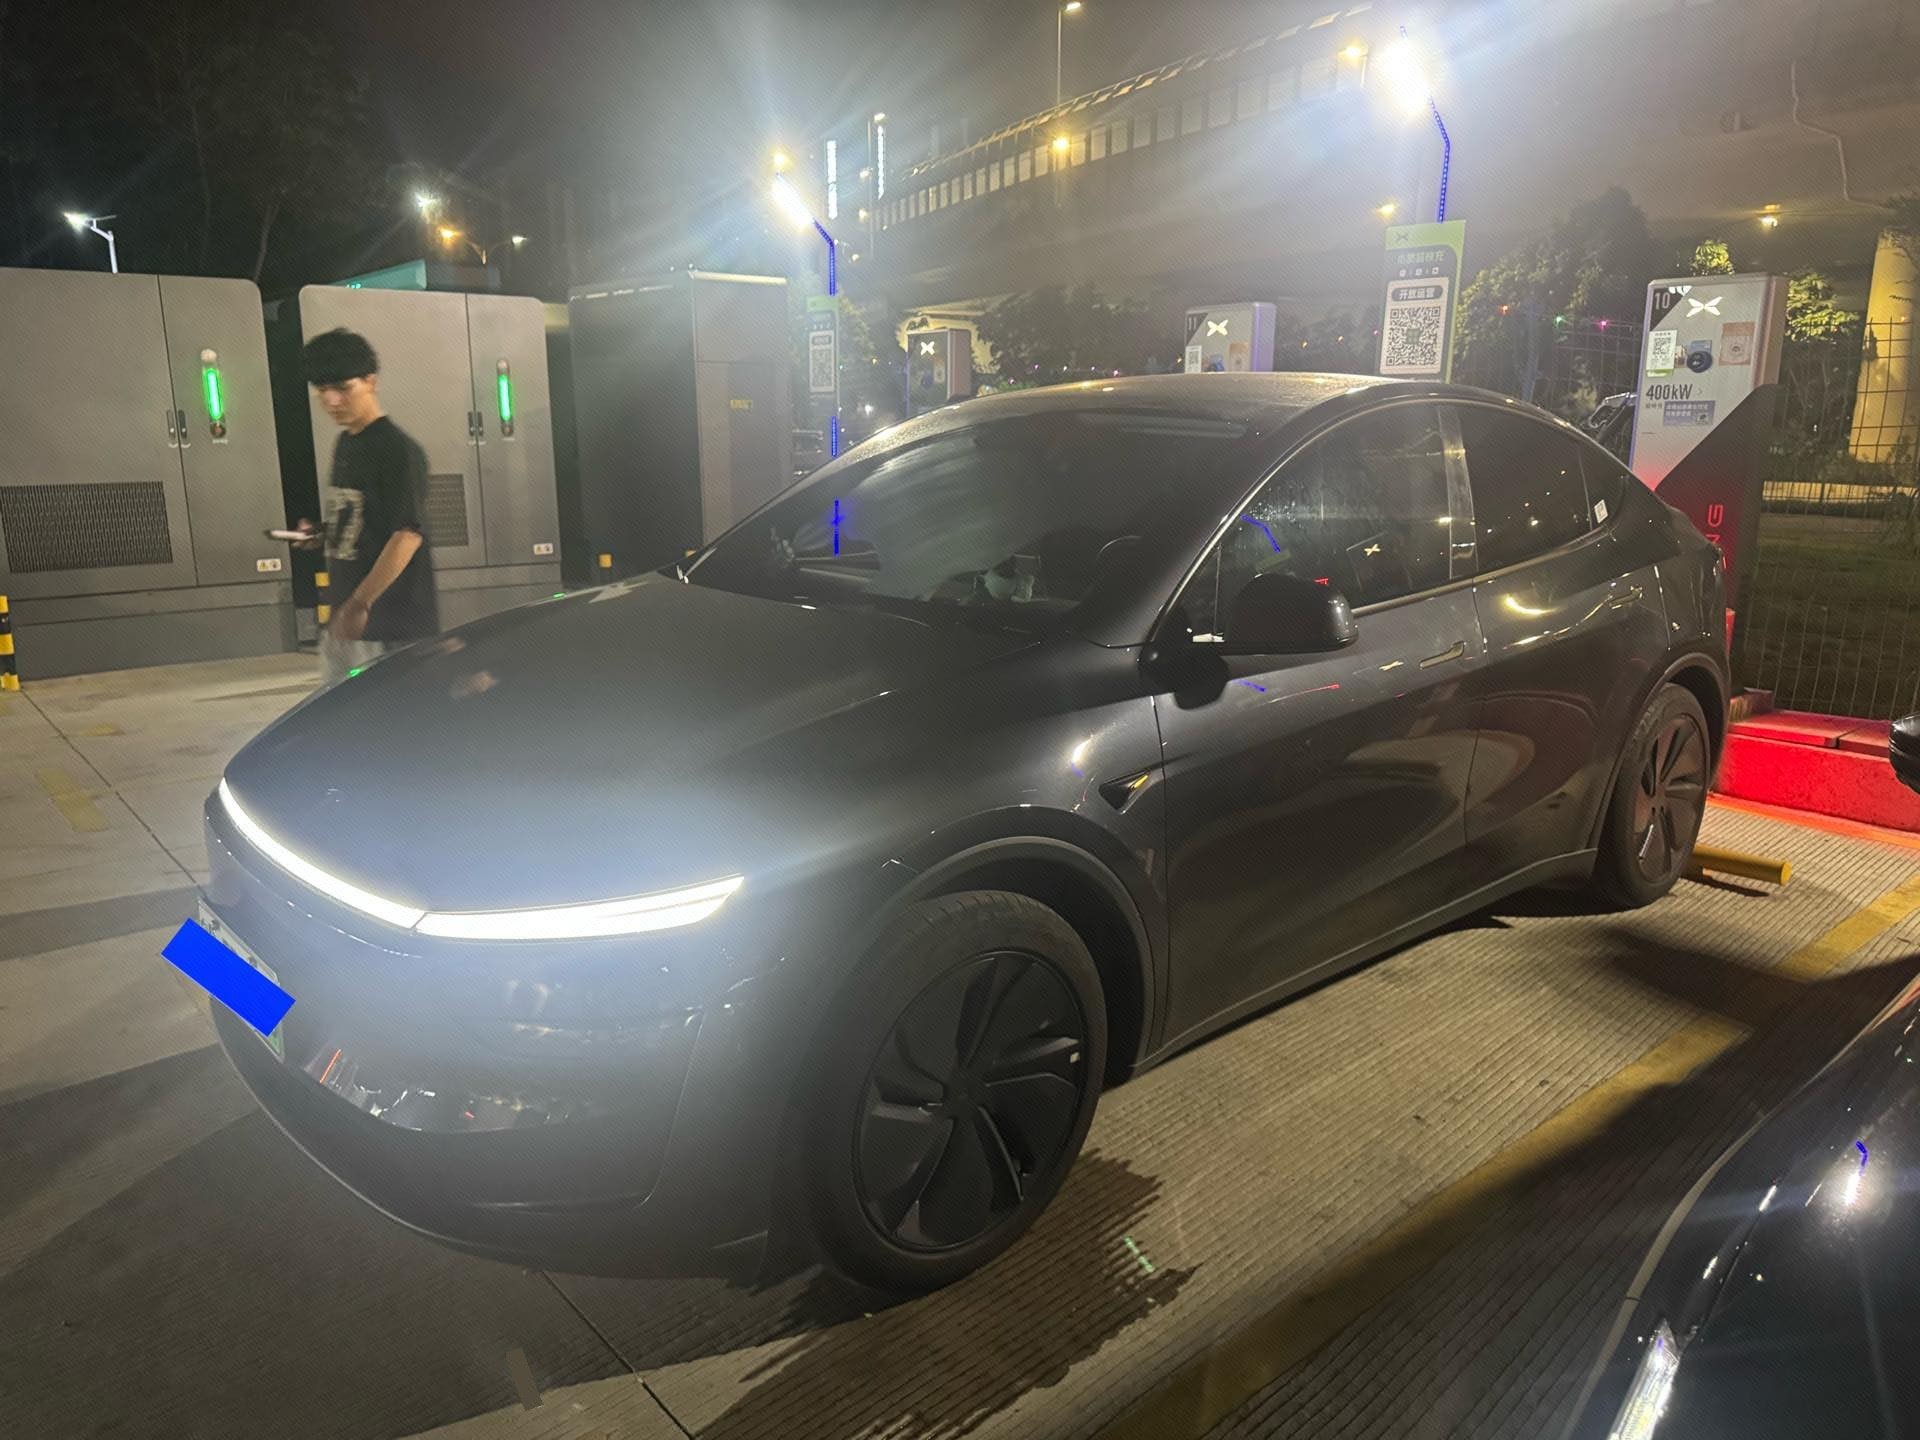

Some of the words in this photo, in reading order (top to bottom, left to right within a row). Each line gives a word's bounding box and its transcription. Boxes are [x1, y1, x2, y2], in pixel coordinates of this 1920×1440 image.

[1399, 287, 1435, 300] 开放运营
[1654, 292, 1671, 310] 10
[1645, 383, 1693, 401] 400kW
